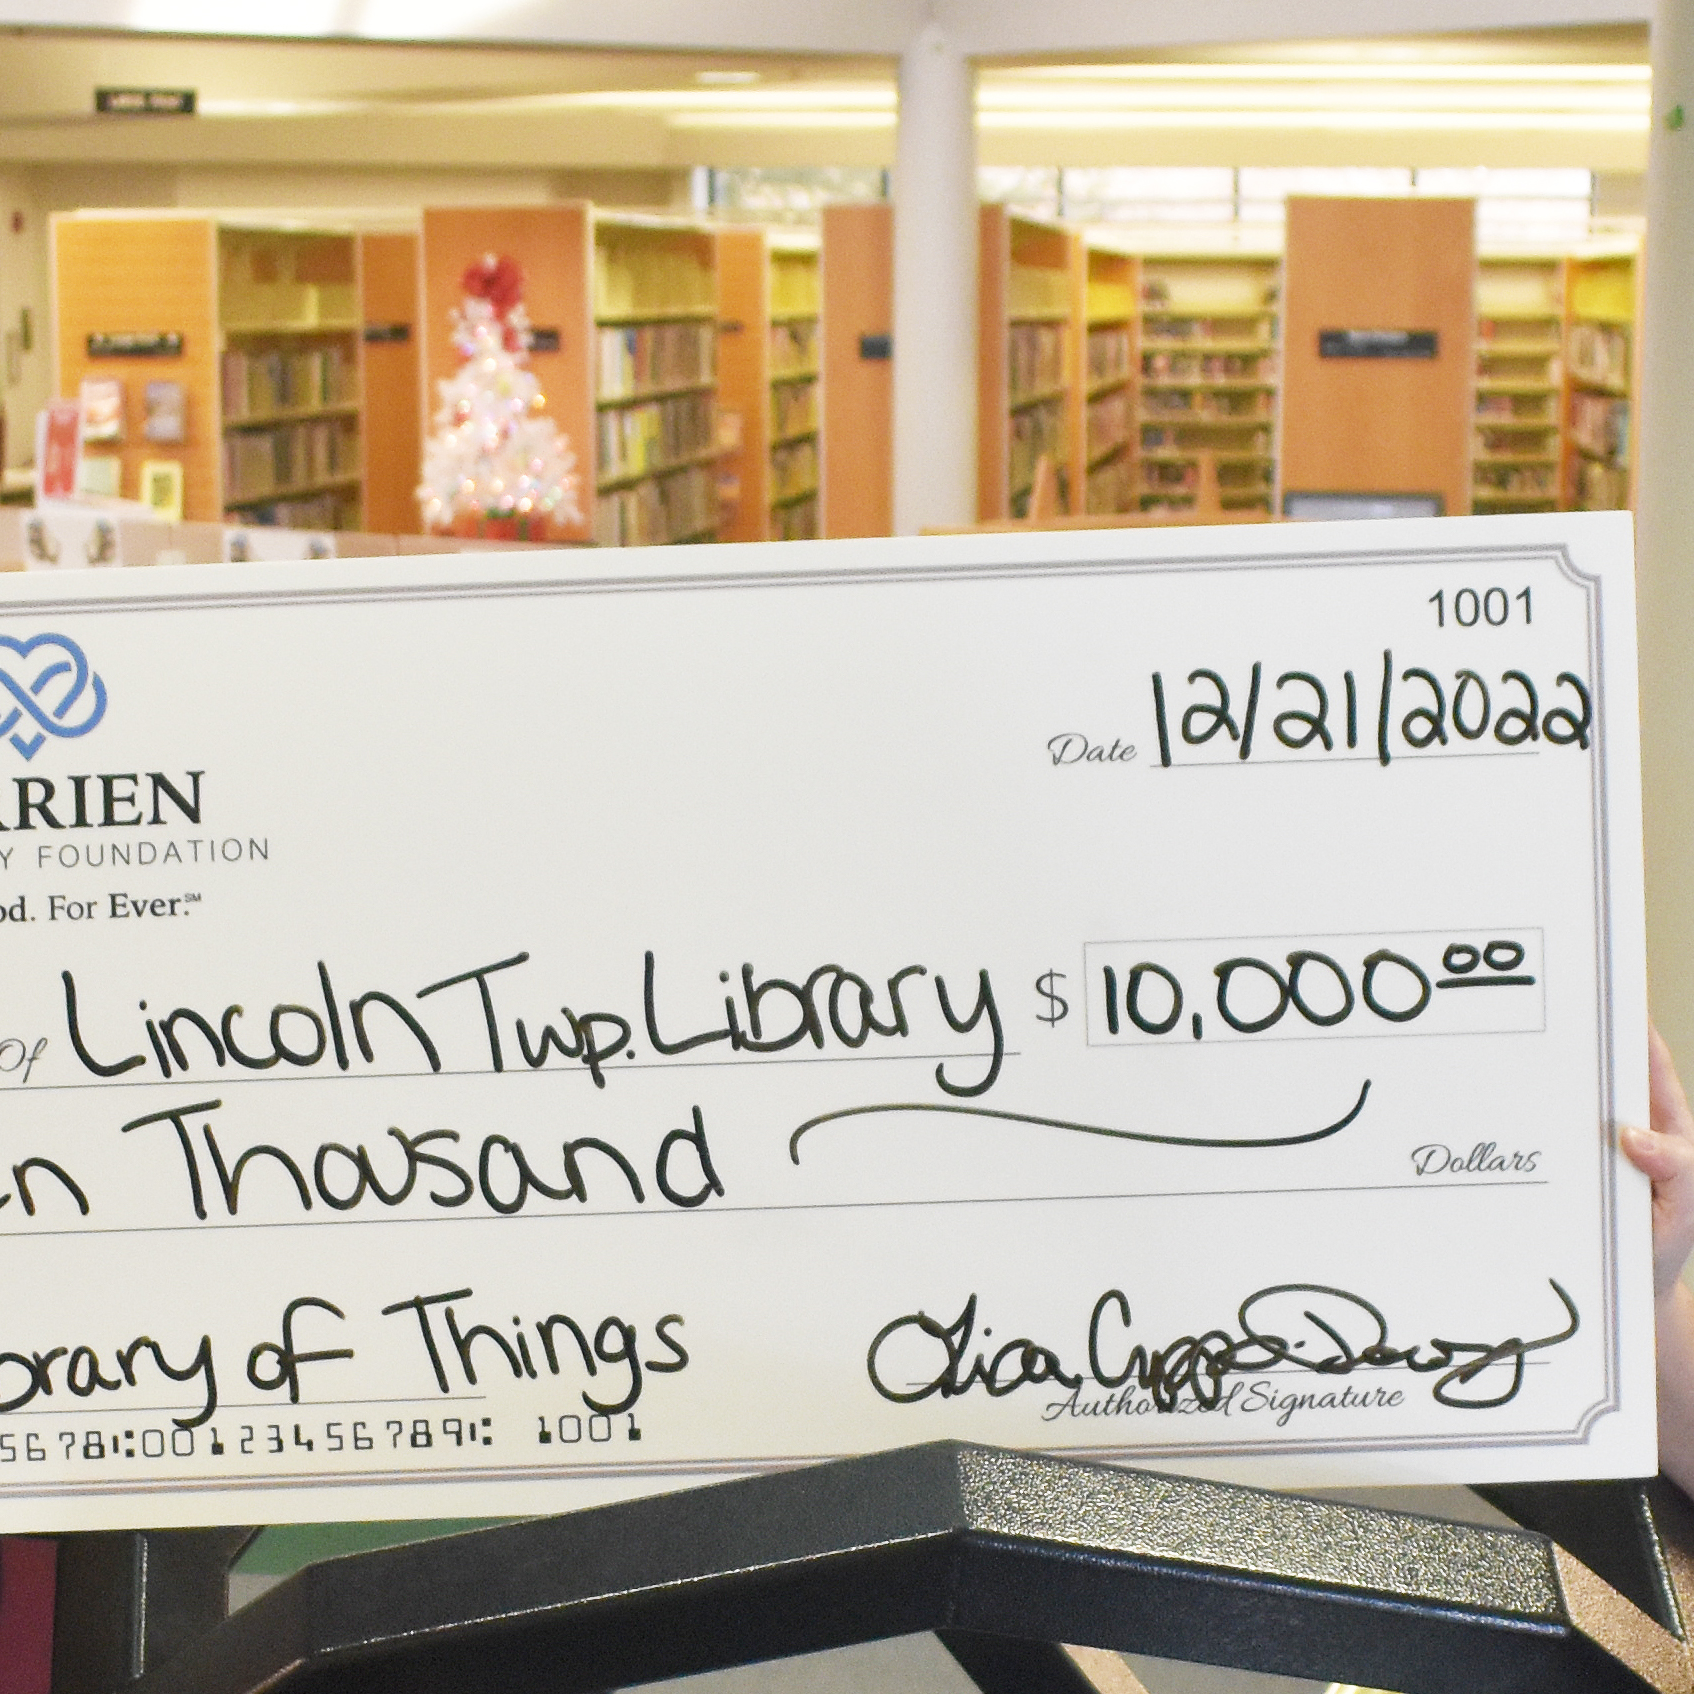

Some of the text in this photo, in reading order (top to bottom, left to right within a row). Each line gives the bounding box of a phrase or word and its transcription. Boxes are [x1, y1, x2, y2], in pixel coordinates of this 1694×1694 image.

[1426, 587, 1534, 628] 1001
[1151, 648, 1593, 768] 12/21/2022
[1048, 732, 1138, 767] Date
[37, 837, 270, 869] FOUNDATION
[48, 894, 98, 921] For
[1034, 969, 1069, 1029] $
[61, 960, 442, 1079] Lincoln
[643, 949, 1004, 1099] Library
[120, 1098, 725, 1221] Thousand
[1410, 1142, 1543, 1178] Dollars
[246, 1296, 356, 1405] of
[381, 1287, 690, 1416] Things
[1239, 1382, 1406, 1428] Signature
